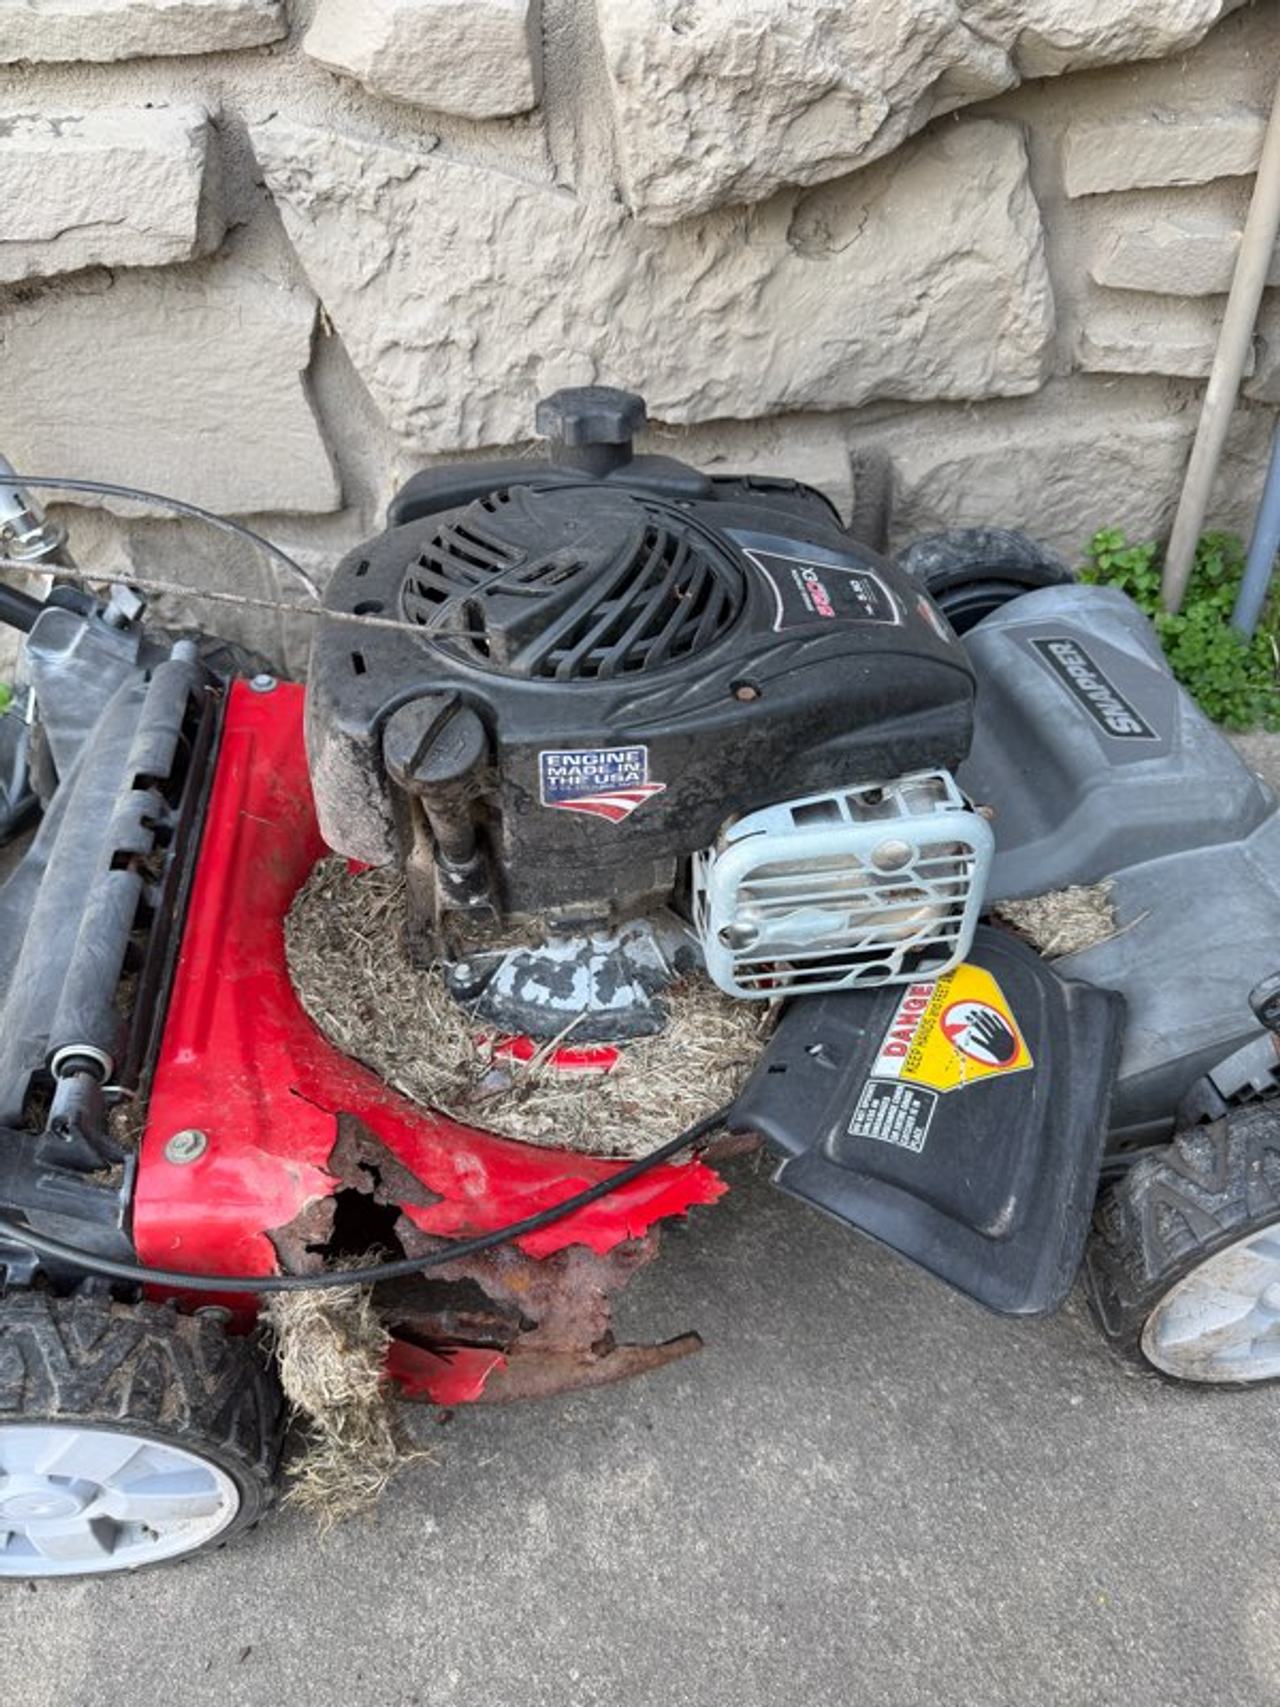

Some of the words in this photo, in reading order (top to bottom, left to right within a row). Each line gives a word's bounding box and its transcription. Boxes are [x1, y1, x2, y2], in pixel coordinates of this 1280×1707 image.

[1047, 640, 1143, 733] SNAPPER
[547, 751, 640, 766] ENGINE
[618, 763, 640, 772] IN
[595, 772, 640, 785] USA
[882, 985, 934, 1057] DANGE
